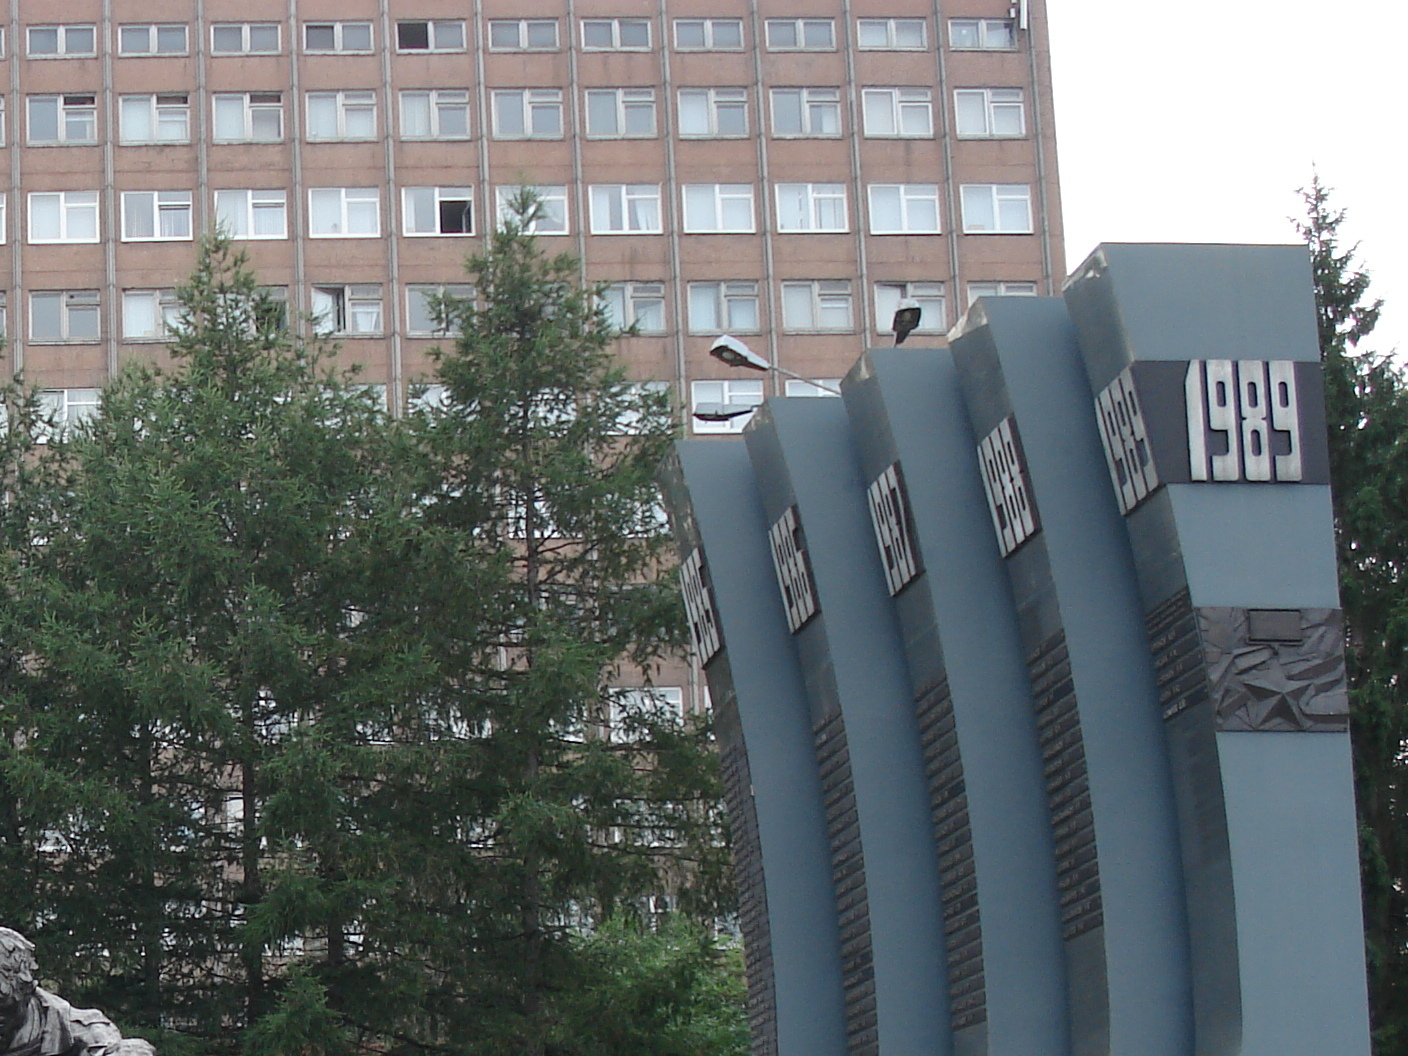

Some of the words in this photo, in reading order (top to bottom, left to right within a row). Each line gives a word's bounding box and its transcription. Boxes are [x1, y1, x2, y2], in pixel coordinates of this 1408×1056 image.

[1094, 366, 1159, 516] 1989
[1185, 359, 1302, 481] 1989
[867, 464, 916, 597] 1987
[977, 417, 1034, 558] 1988
[679, 547, 720, 668] 1985
[769, 506, 815, 634] 1986
